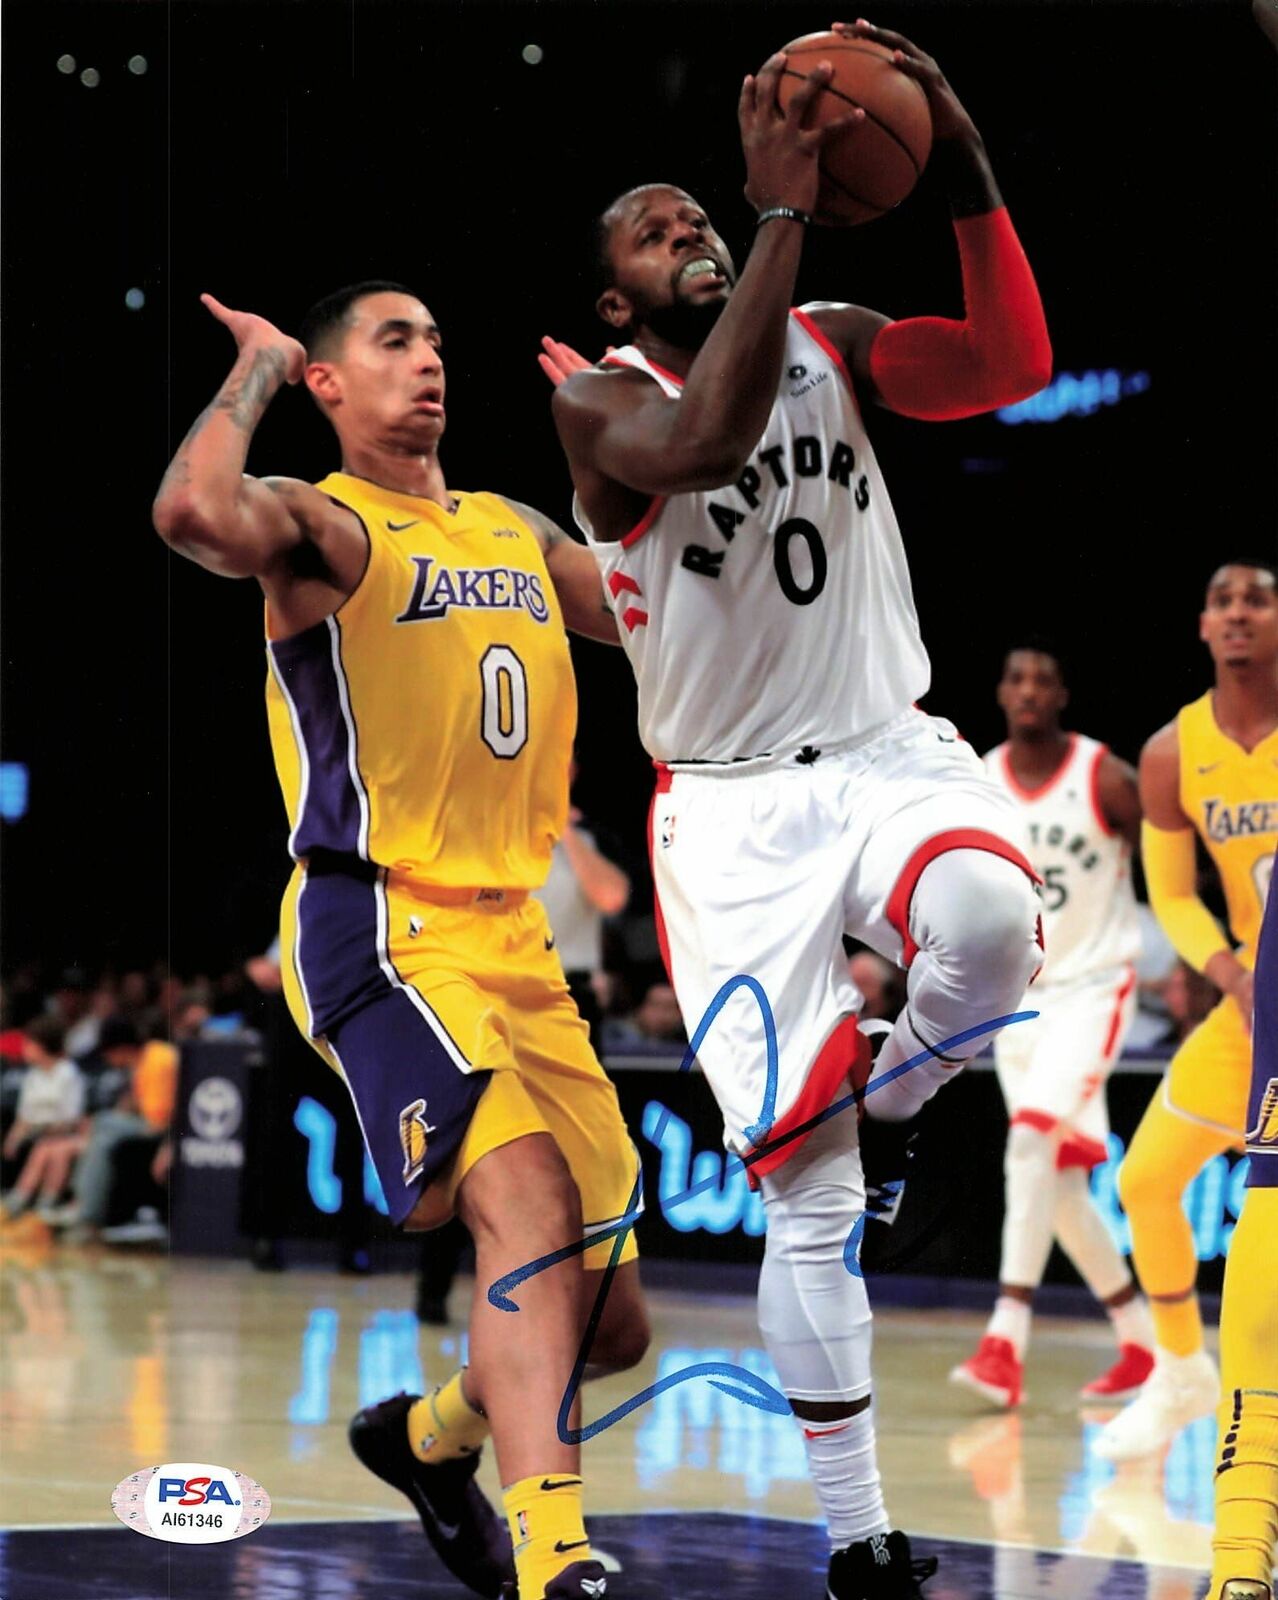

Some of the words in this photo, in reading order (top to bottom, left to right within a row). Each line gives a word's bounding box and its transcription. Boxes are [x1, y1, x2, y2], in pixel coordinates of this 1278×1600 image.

[789, 384, 811, 399] Sun
[809, 371, 828, 387] Life
[681, 435, 870, 579] RAPTORS
[396, 556, 550, 624] LAKERS
[773, 517, 828, 606] 0
[479, 643, 529, 761] 0
[161, 1512, 223, 1529] AI61346
